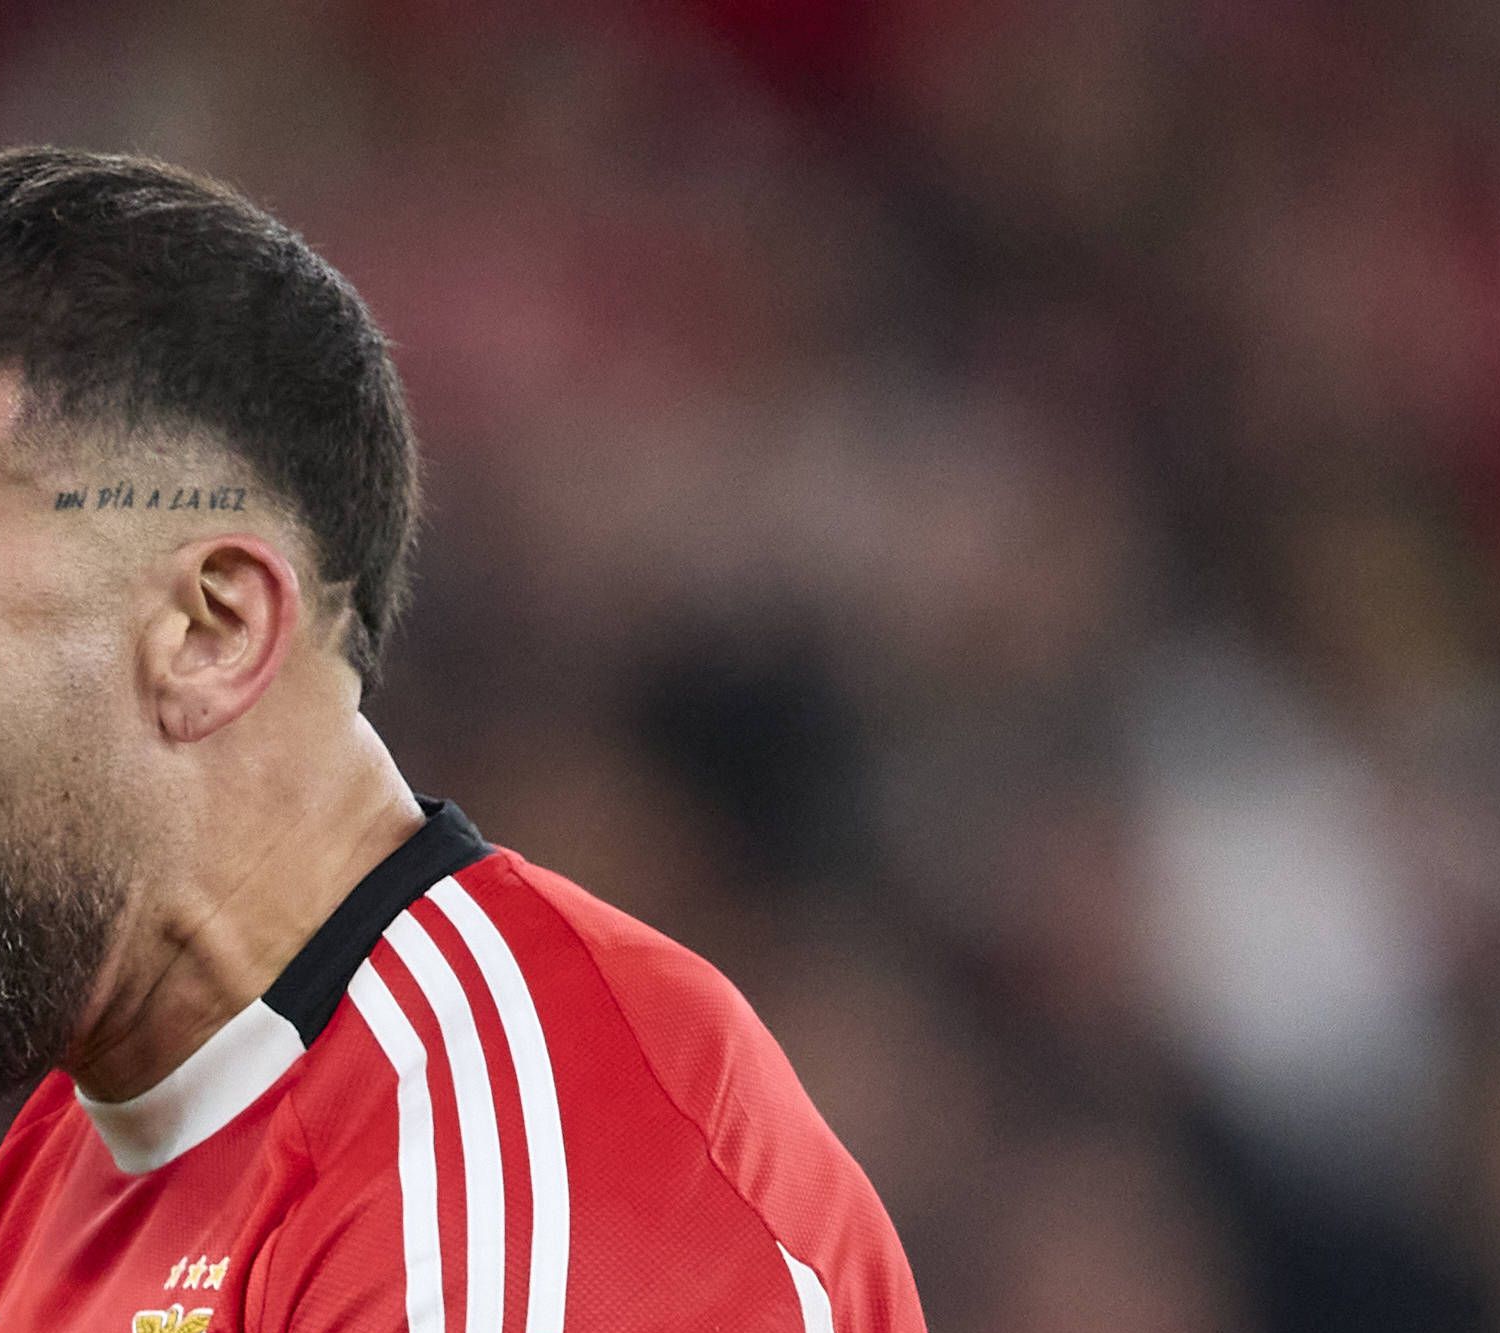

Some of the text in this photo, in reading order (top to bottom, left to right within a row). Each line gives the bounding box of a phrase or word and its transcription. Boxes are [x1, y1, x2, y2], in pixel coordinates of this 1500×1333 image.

[146, 488, 160, 509] A
[169, 487, 200, 510] LA
[209, 485, 247, 512] VEZ
